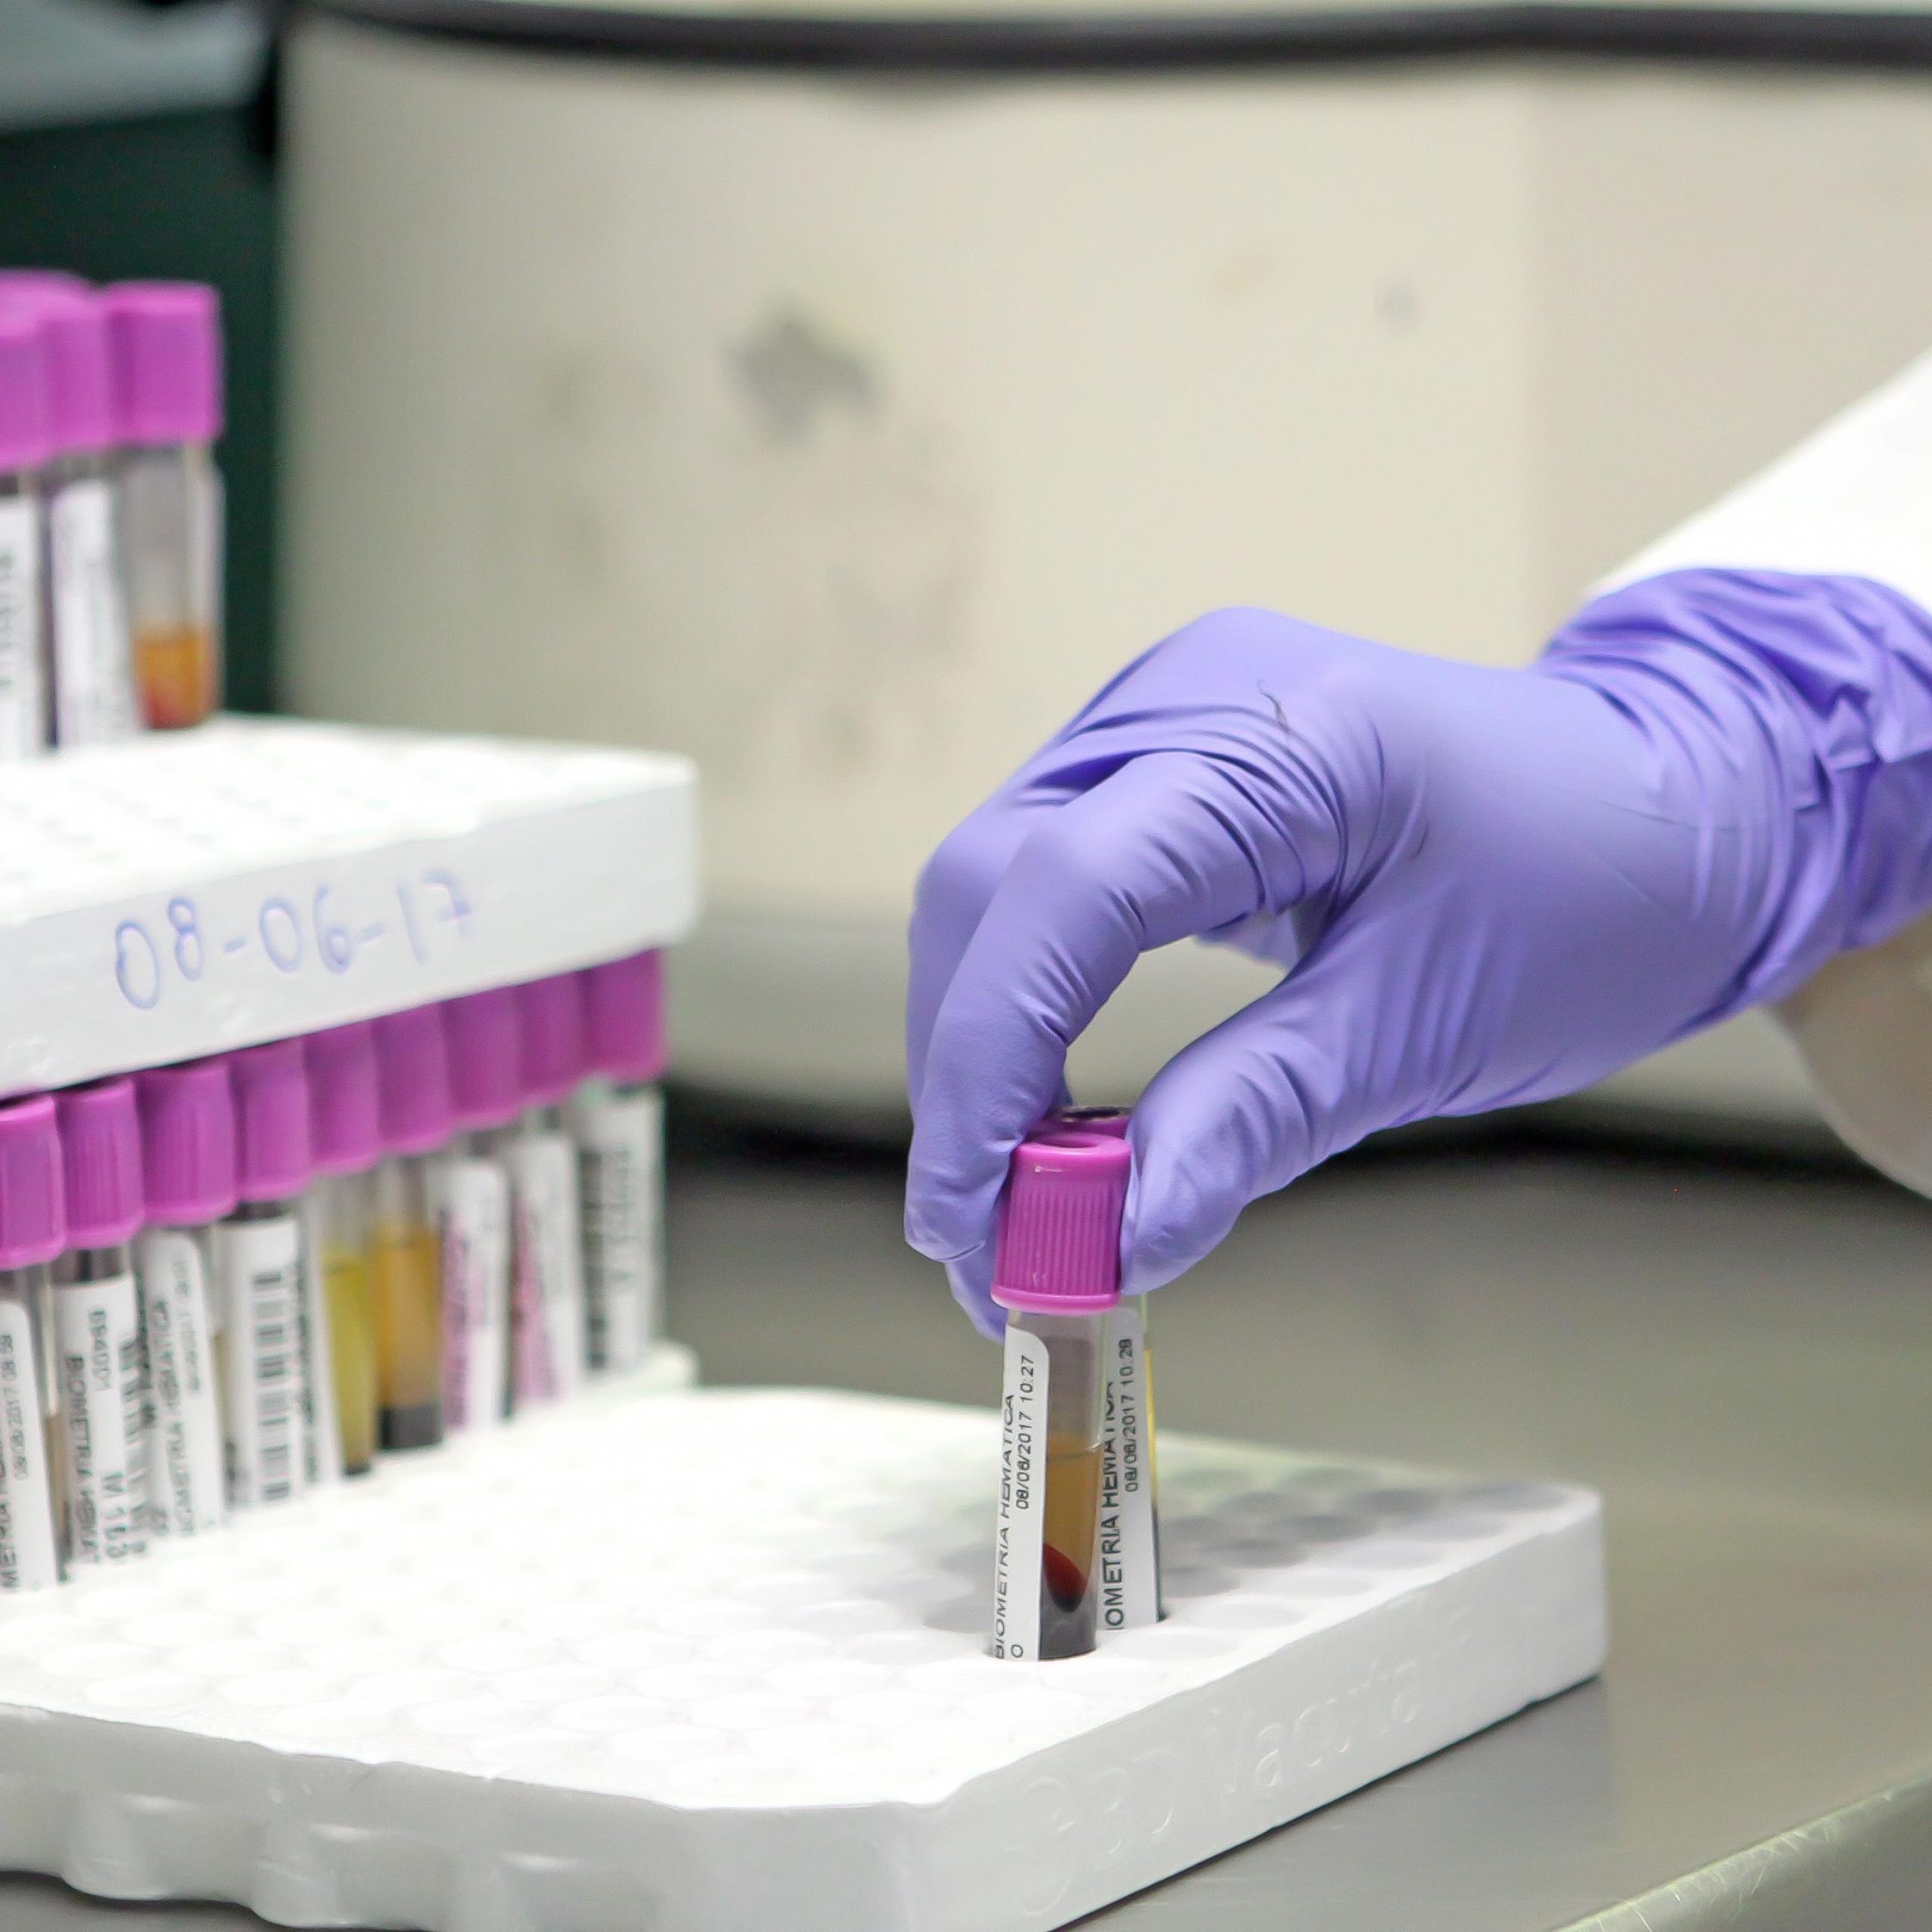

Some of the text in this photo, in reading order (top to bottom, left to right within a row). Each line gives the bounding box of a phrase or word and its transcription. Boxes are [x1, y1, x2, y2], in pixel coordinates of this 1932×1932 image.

[115, 868, 471, 1010] 08-06-17
[995, 1393, 1015, 1660] BIOMETRIA HEMATICA
